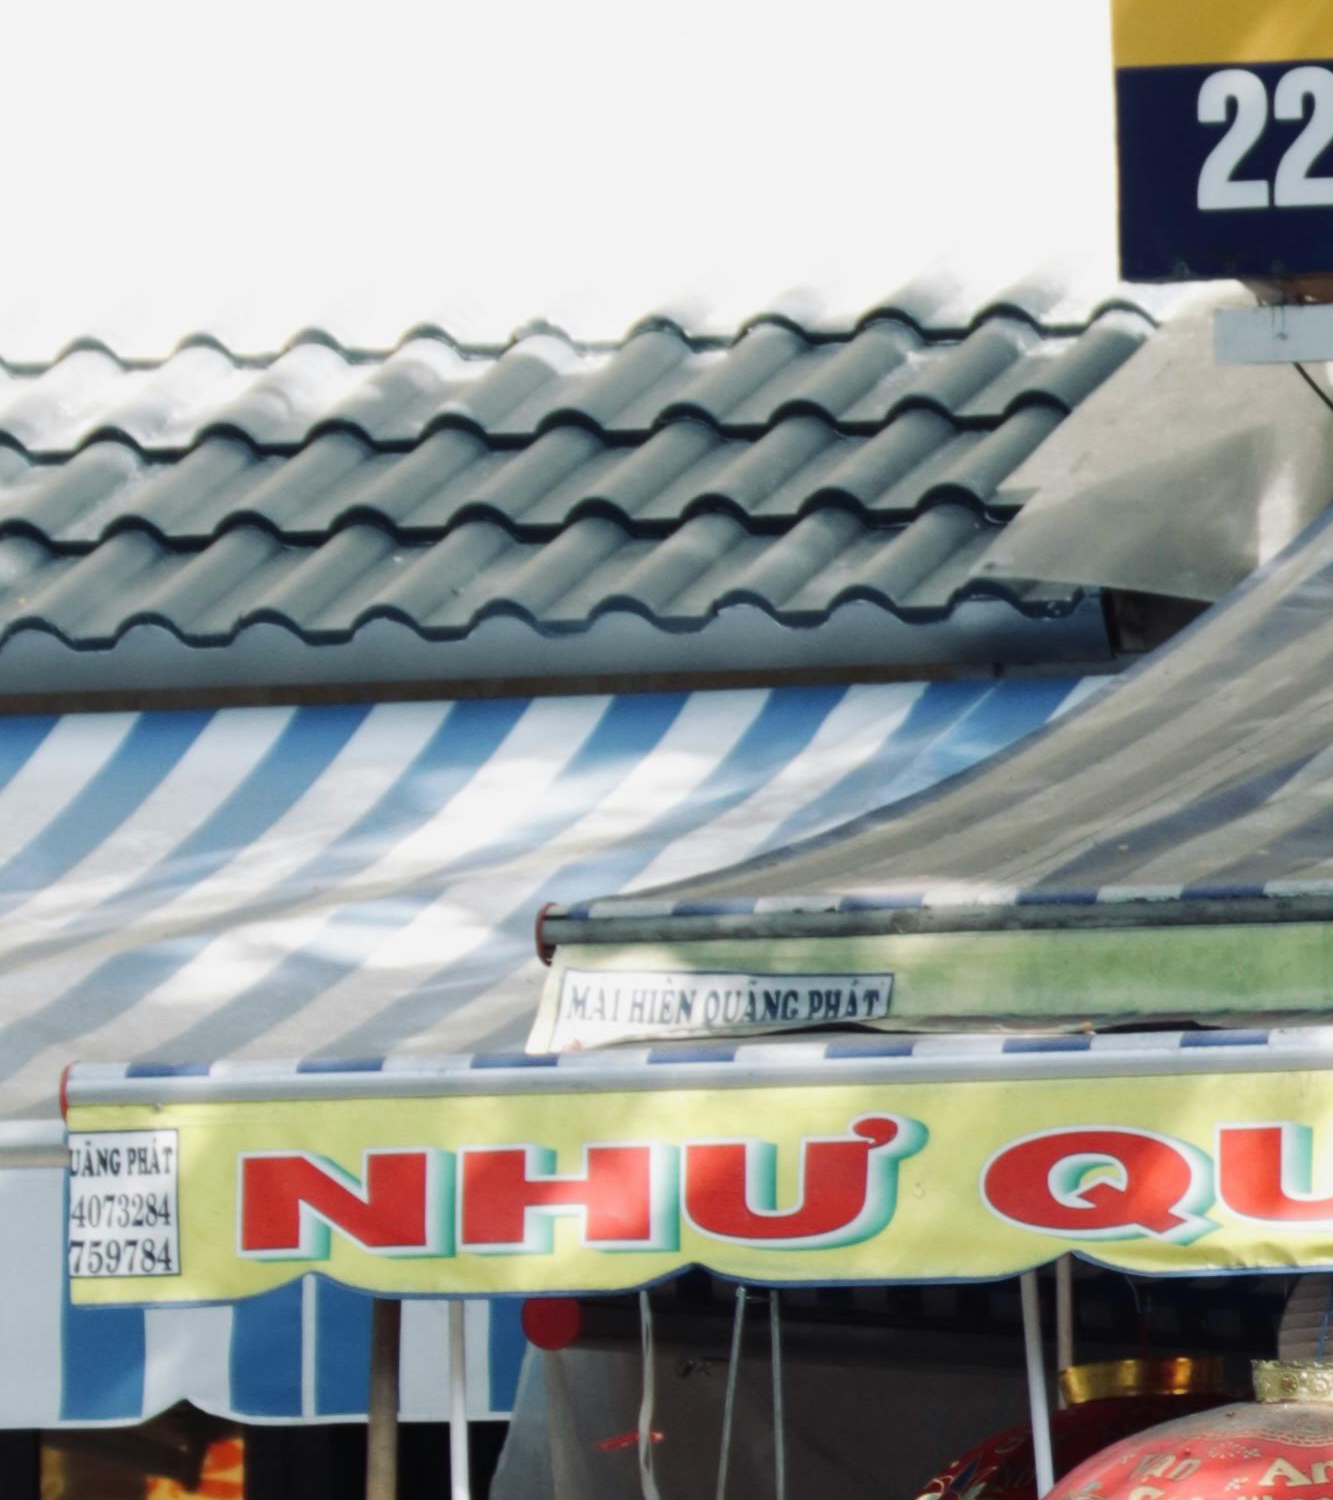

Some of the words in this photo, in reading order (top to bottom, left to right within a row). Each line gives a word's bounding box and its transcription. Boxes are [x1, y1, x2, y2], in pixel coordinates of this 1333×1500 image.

[806, 978, 882, 1021] PHÁT
[126, 1136, 174, 1176] PHÁT
[236, 1114, 928, 1258] NHƯ
[71, 1191, 171, 1229] 4073284
[69, 1238, 173, 1275] 759784
